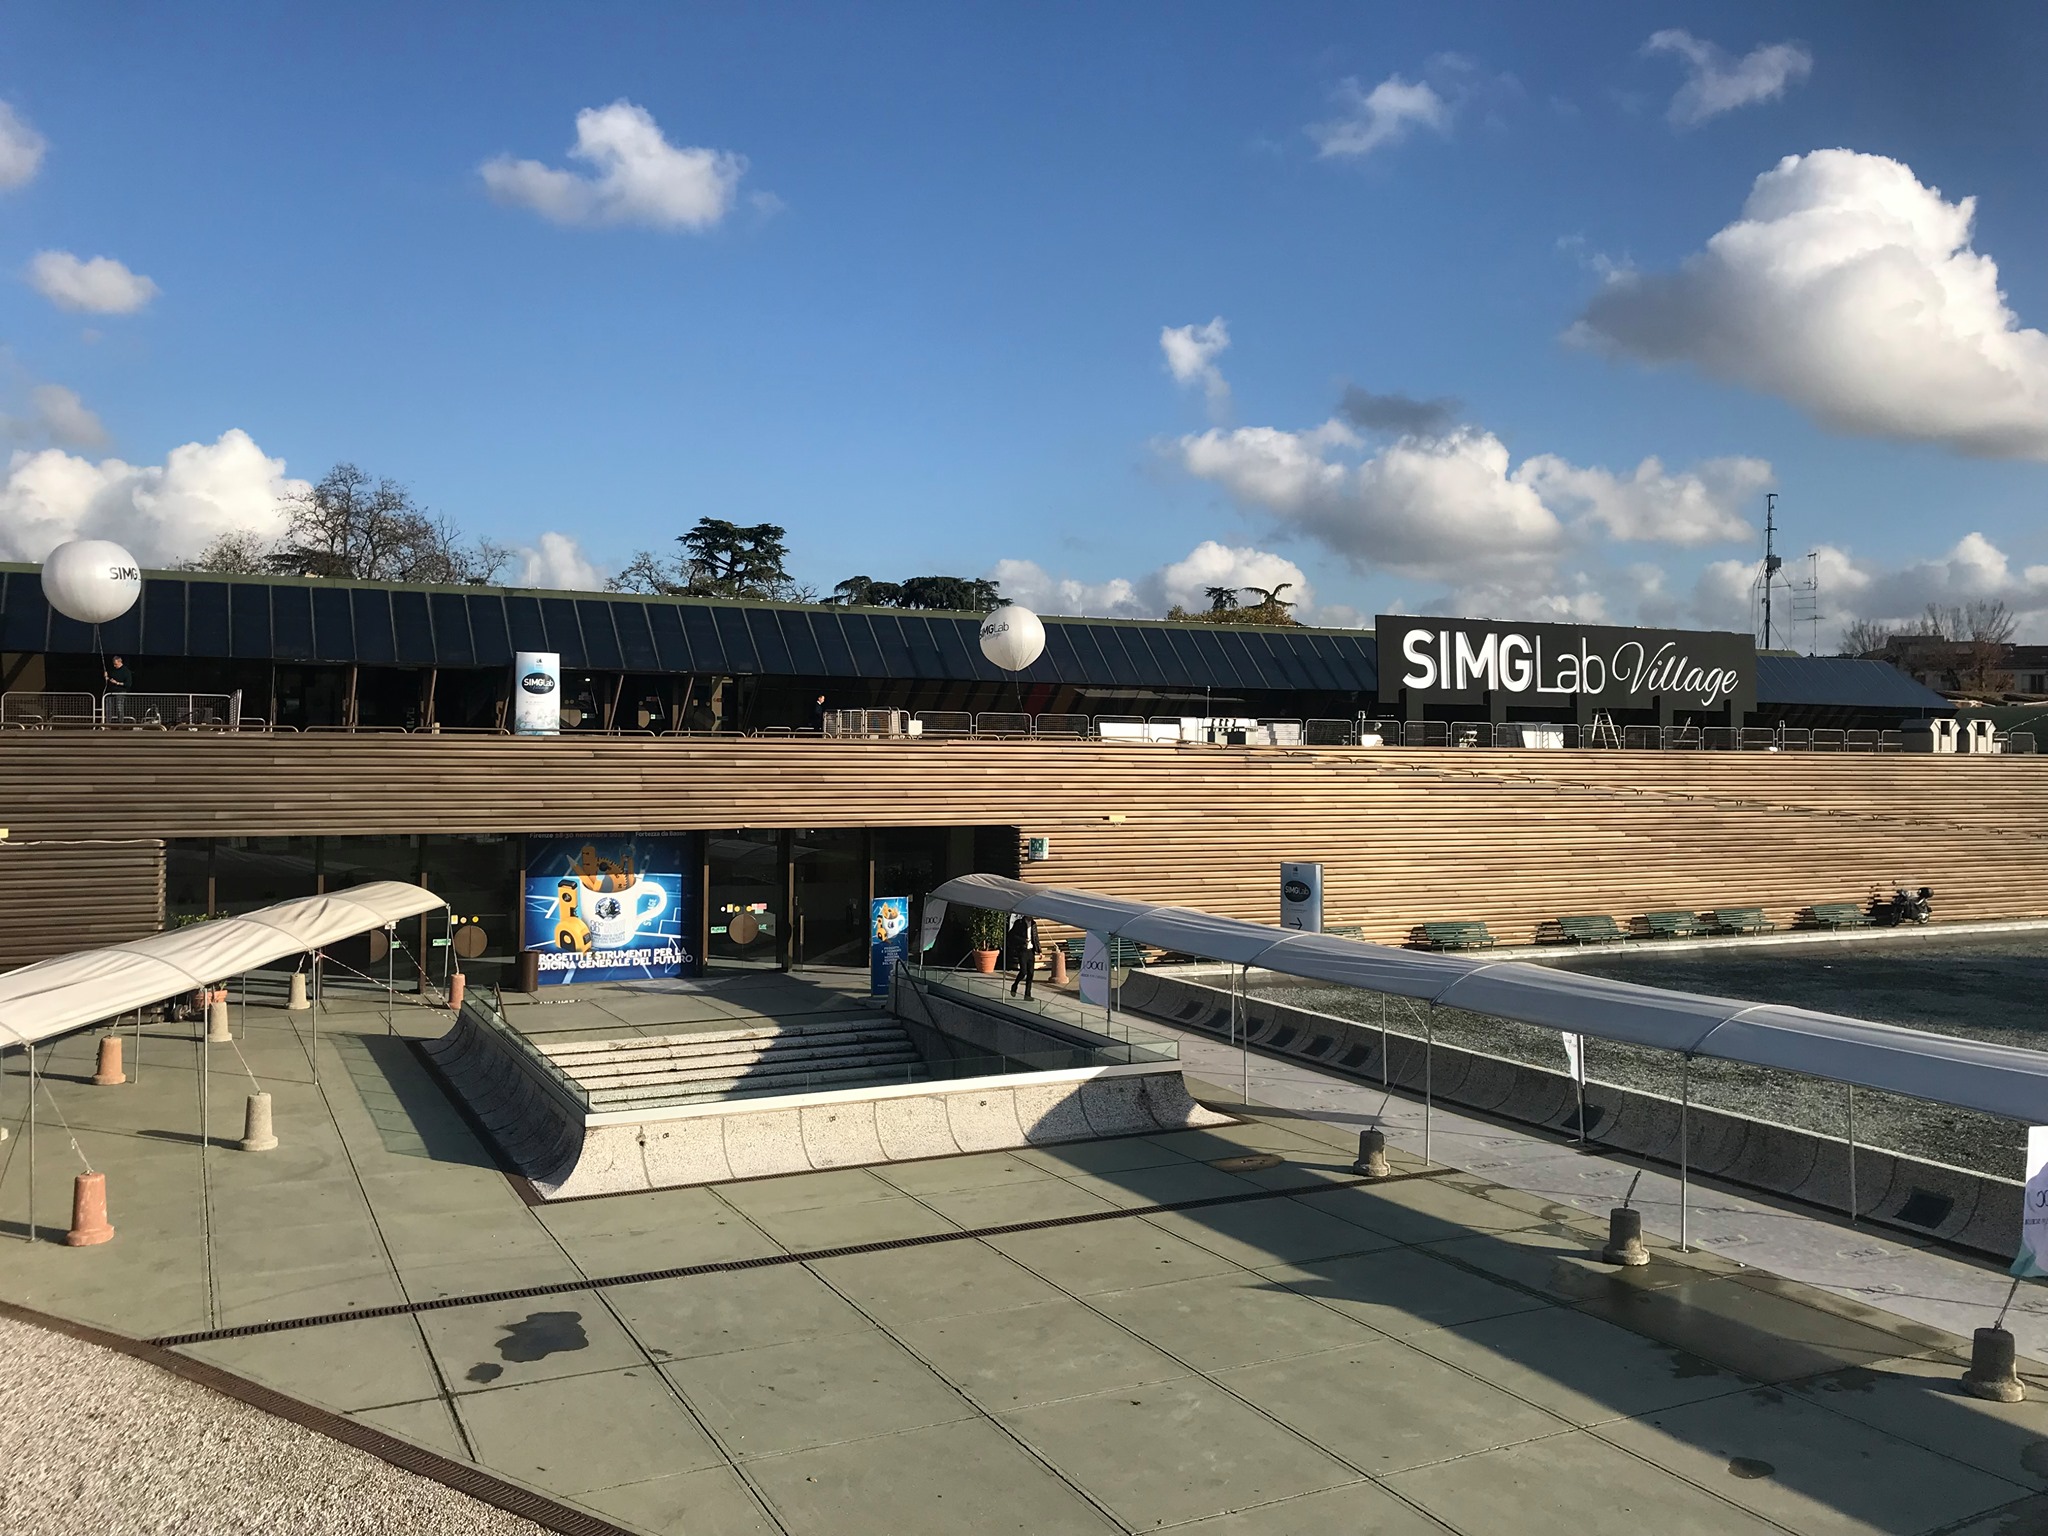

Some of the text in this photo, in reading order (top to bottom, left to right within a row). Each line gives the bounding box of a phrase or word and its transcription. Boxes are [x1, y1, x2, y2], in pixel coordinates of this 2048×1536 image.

[109, 567, 140, 581] SIMG
[1402, 628, 1740, 707] SIMGLab Village
[523, 678, 554, 687] SIMGLab
[538, 946, 688, 962] ROGETTI E STRUMENTI PER LA
[538, 954, 693, 970] DICINA GENERALE DEL FUTURO
